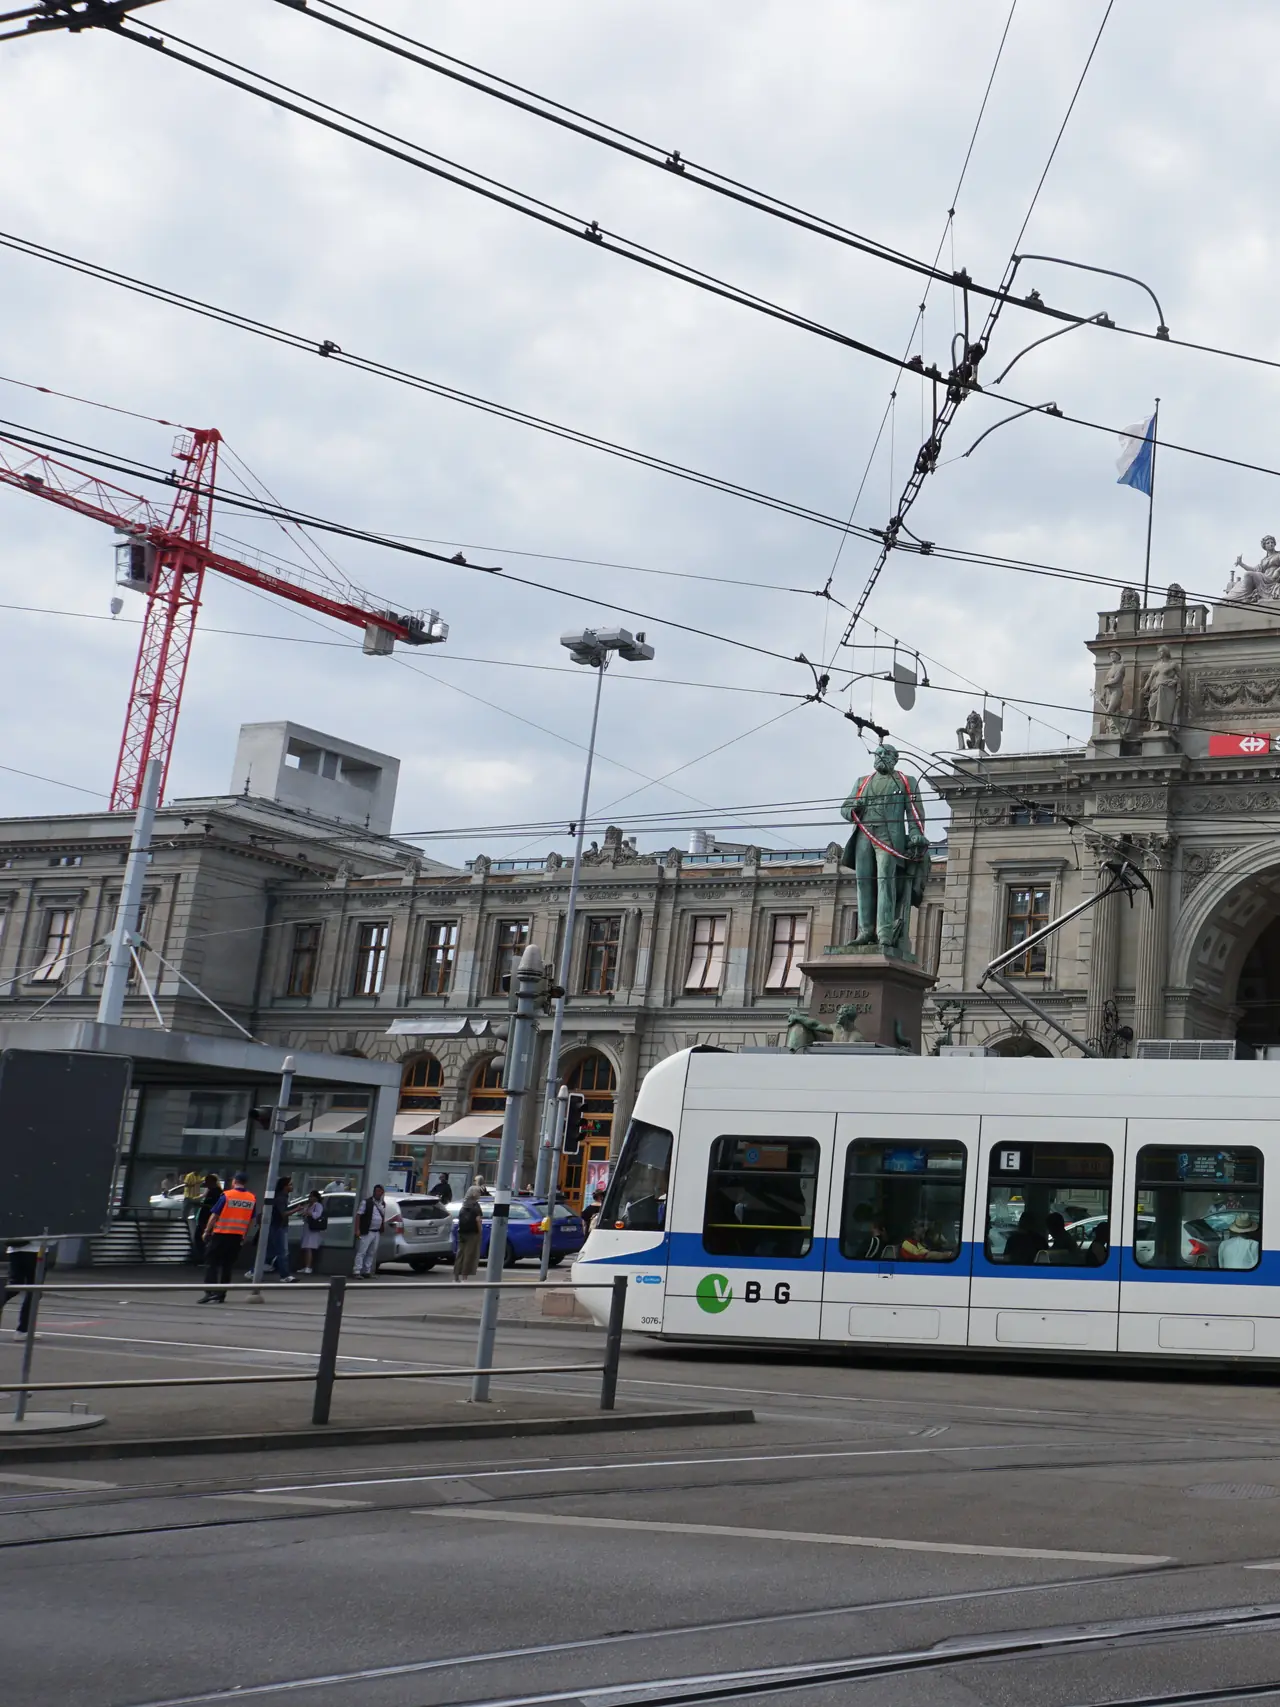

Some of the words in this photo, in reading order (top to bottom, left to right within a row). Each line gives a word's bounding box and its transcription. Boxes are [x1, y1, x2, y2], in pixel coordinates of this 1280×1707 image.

[824, 989, 870, 999] ALFRED
[818, 1003, 873, 1014] ESCER
[1006, 1153, 1015, 1168] E
[641, 1316, 659, 1325] 3076
